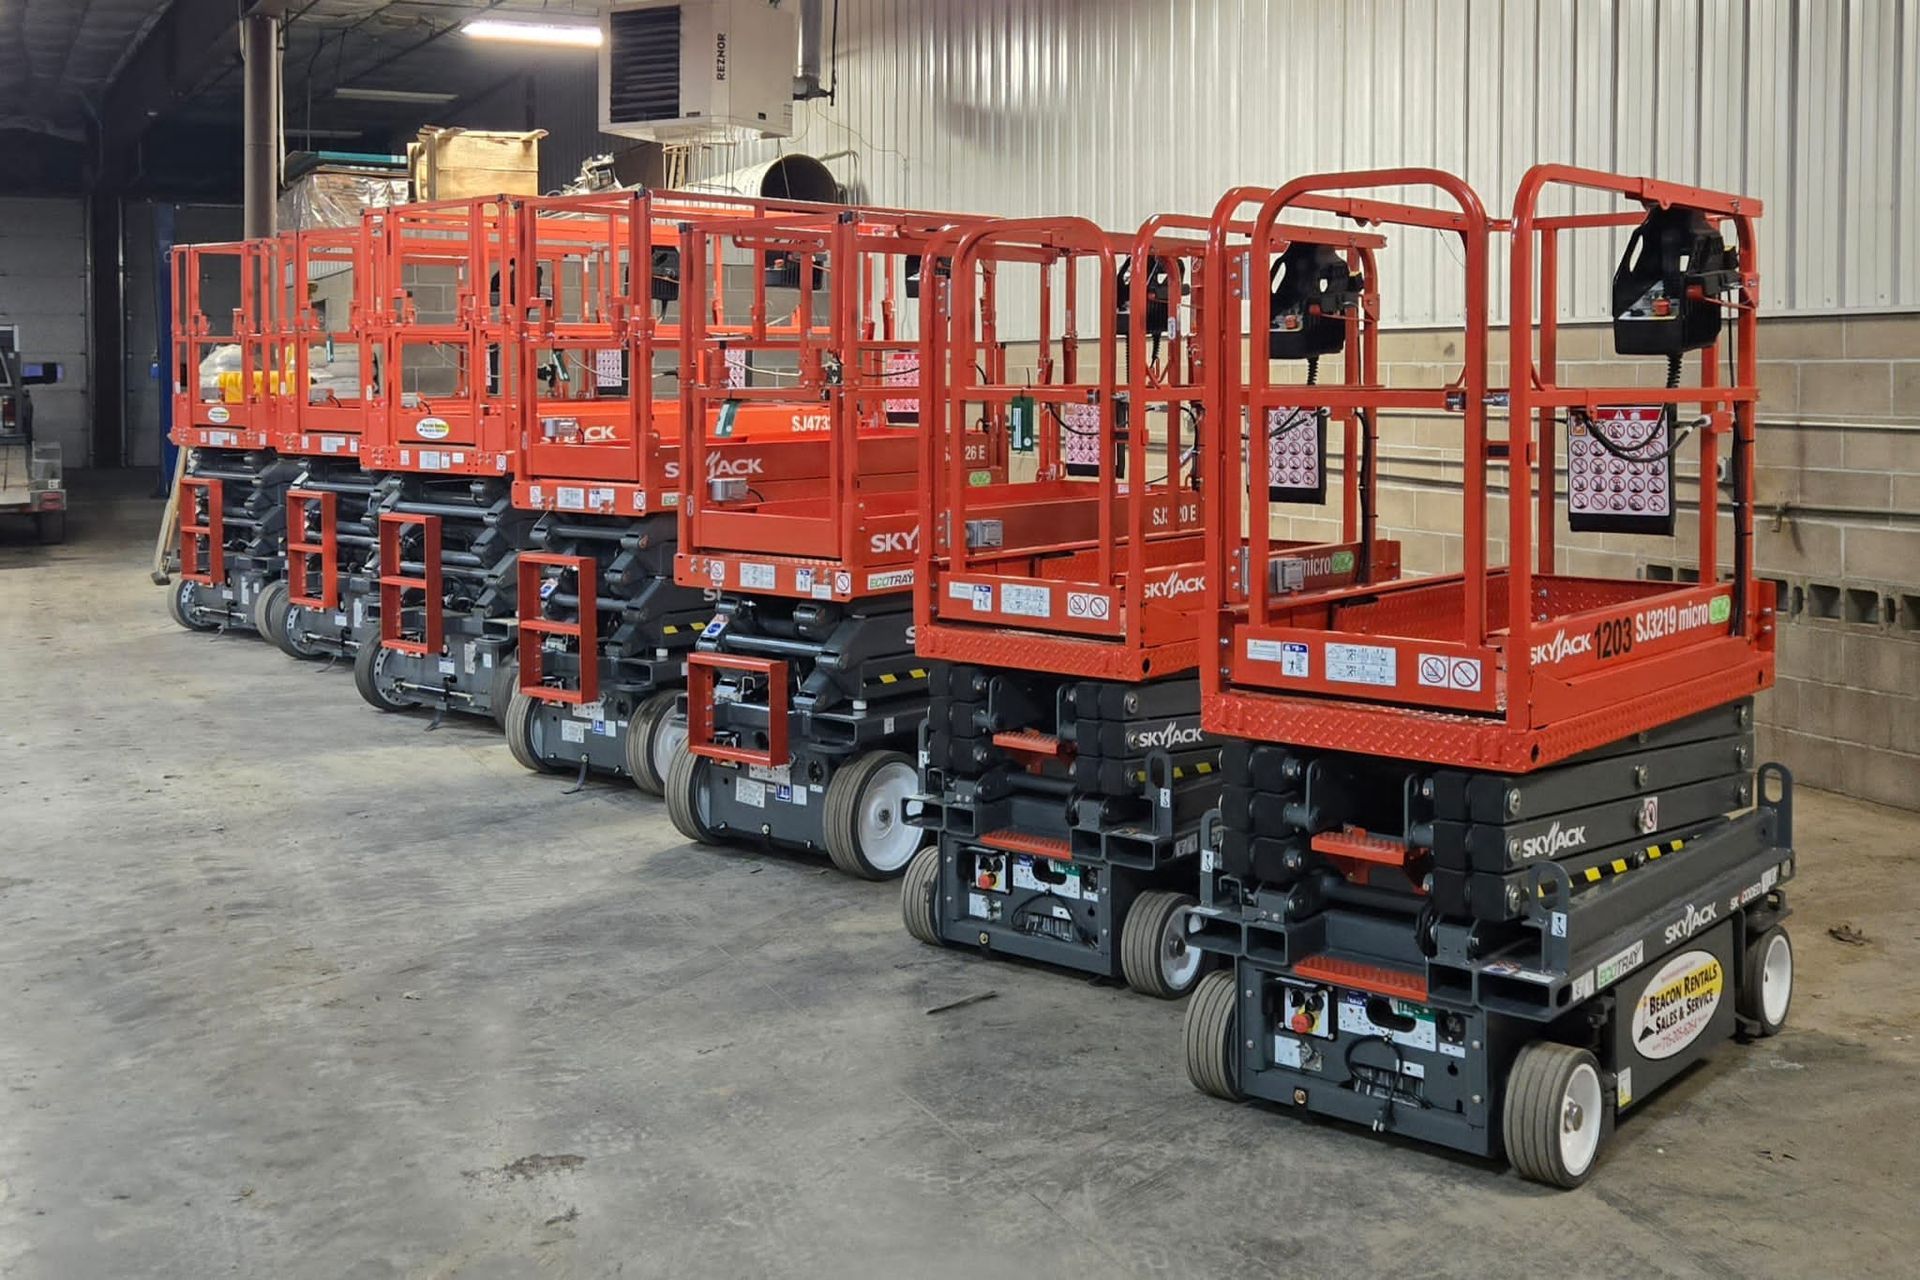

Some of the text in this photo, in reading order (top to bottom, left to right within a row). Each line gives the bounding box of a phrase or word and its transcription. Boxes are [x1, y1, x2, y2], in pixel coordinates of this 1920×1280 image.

[717, 33, 726, 80] REZNOR
[705, 451, 764, 483] JACK
[870, 571, 914, 588] ECOTRAY
[1144, 571, 1206, 599] SKYJACK
[1530, 600, 1708, 666] SKYJACK 1203 SJ3219 micro
[1139, 721, 1203, 748] SKYJACK
[1523, 821, 1586, 858] SKYJACK
[1664, 902, 1717, 944] SKYJACK
[1599, 946, 1642, 986] ECOTRAY
[1649, 984, 1682, 1016] BEACON
[1684, 964, 1717, 996] RENTALS
[1656, 1009, 1678, 1035] SALES
[1680, 1006, 1685, 1021] &
[1687, 988, 1714, 1016] SERVICE
